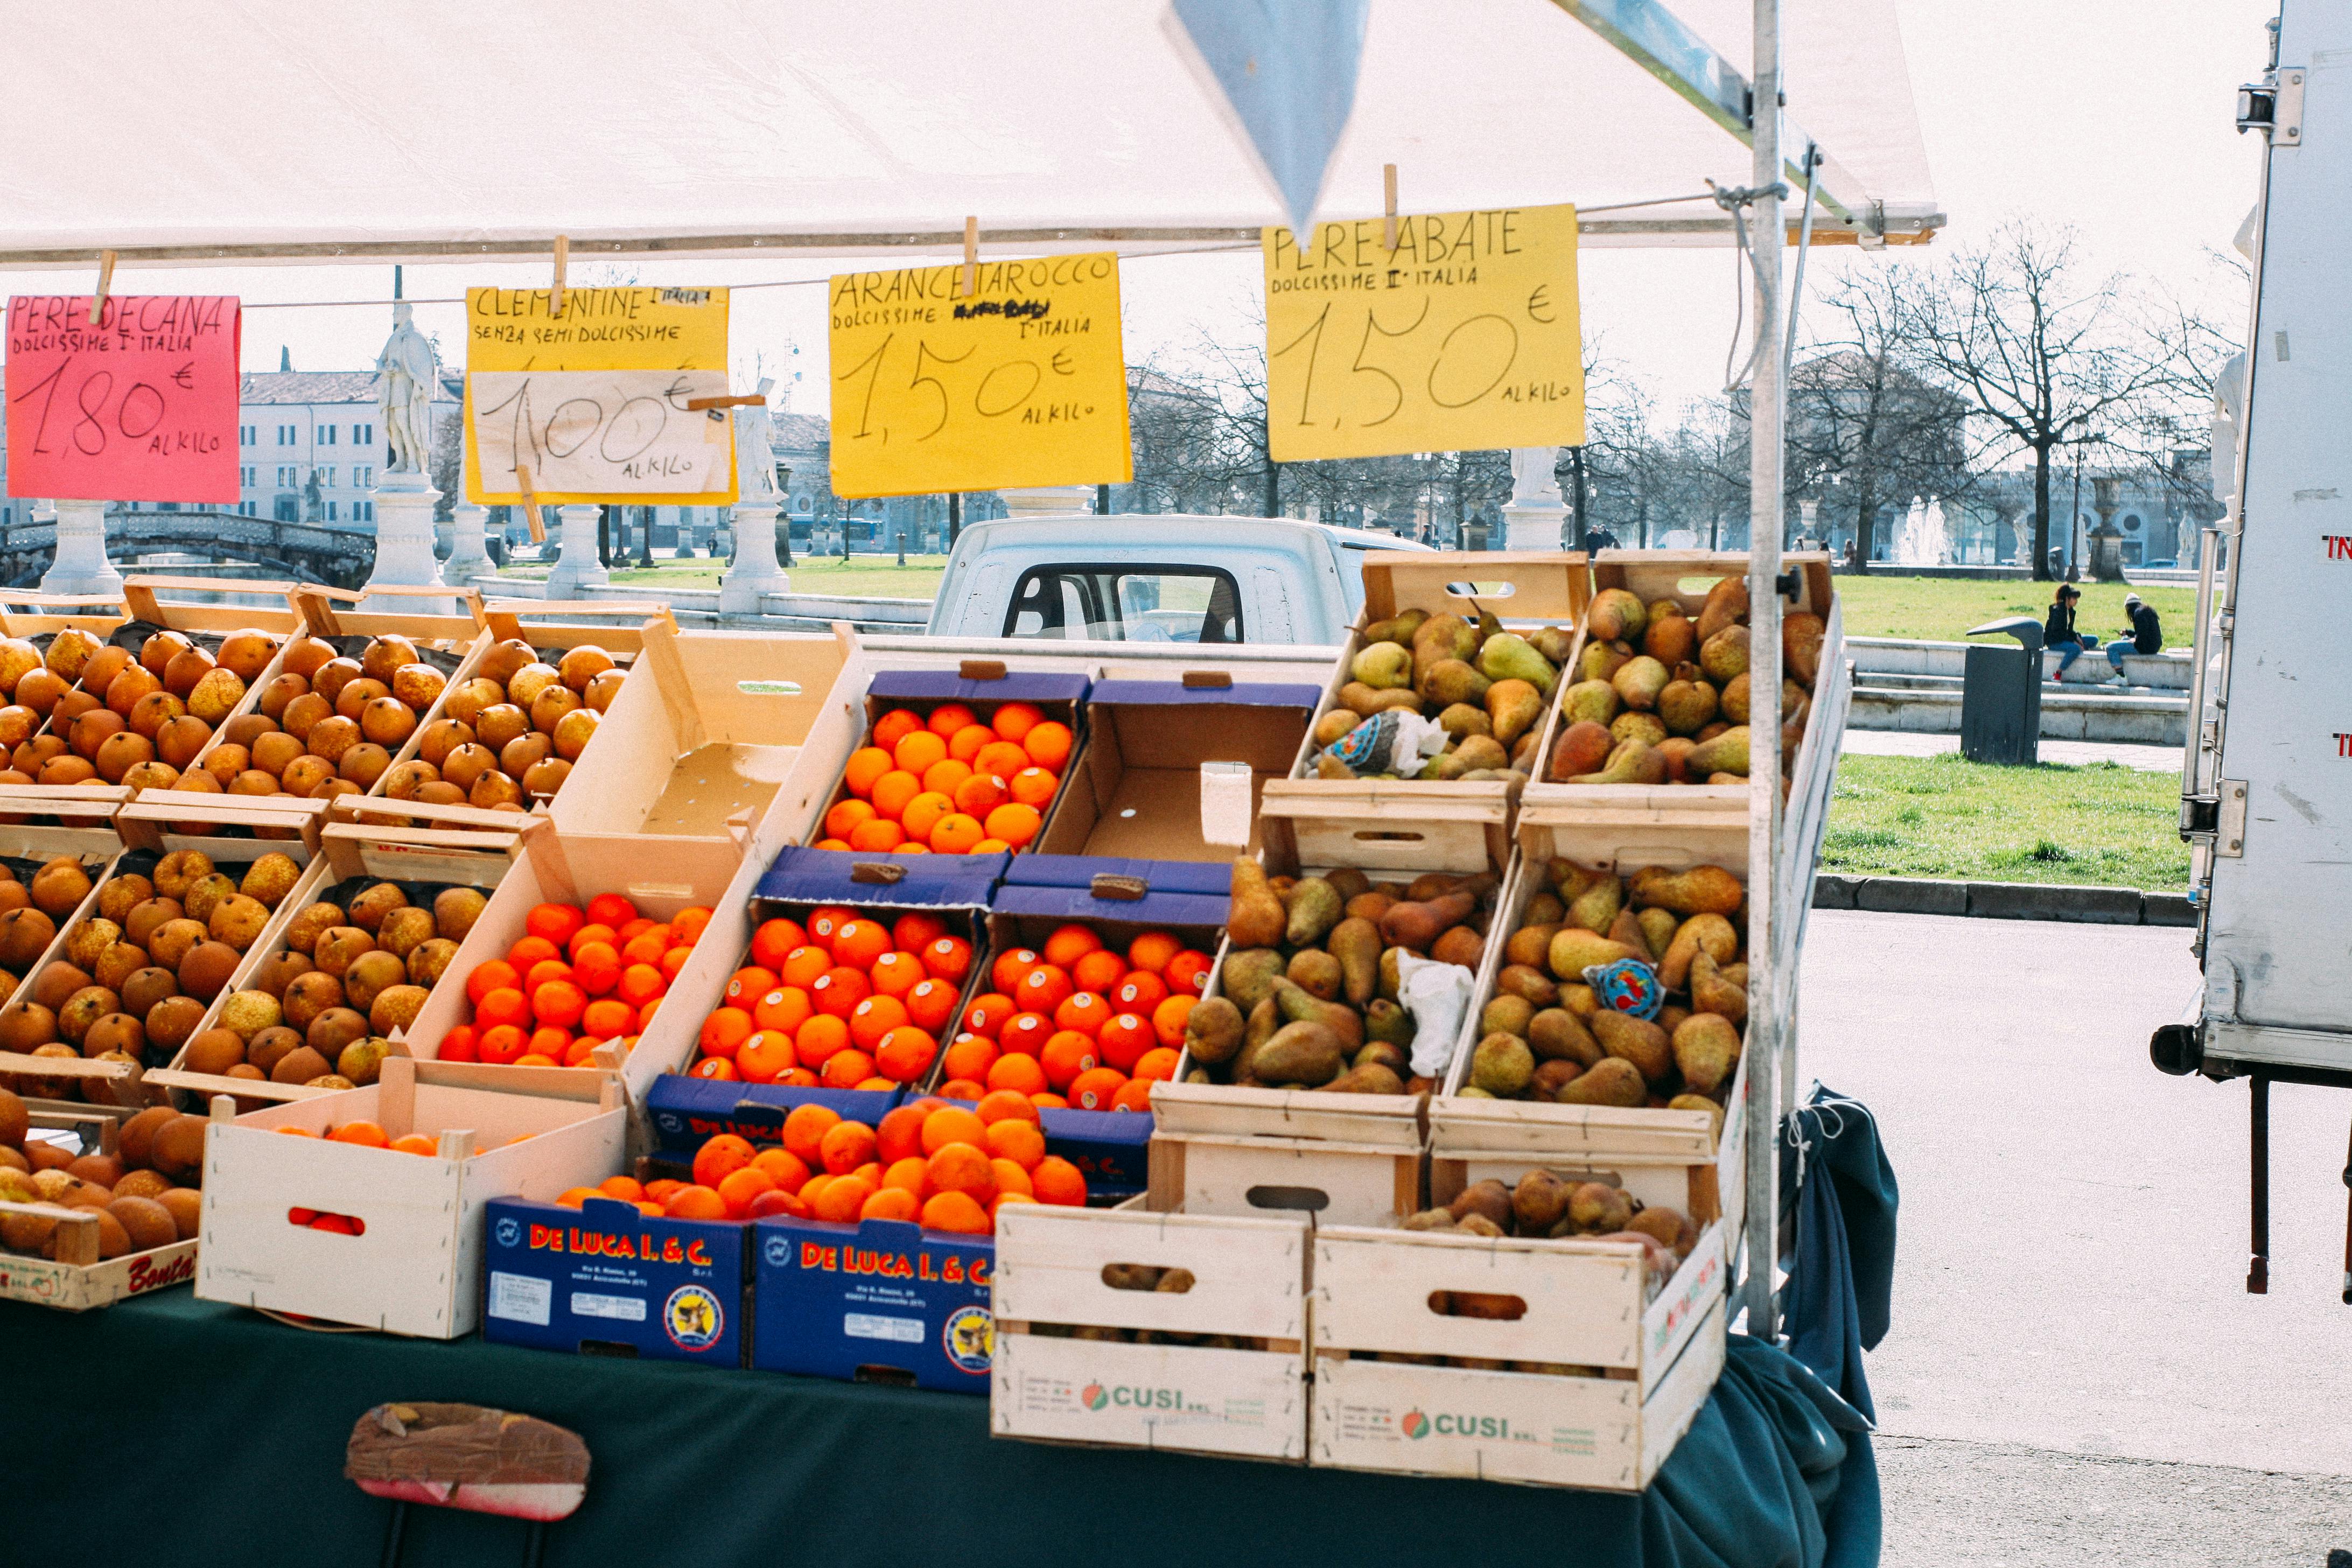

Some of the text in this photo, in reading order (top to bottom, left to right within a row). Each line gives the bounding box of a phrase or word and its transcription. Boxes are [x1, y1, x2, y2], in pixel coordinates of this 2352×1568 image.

[1389, 211, 1523, 267] ABATE
[833, 257, 1111, 308] ARANCE TAROCCO
[1416, 268, 1478, 286] ITALIA
[11, 296, 223, 336] PERE DECANA
[1529, 284, 1556, 324] €
[141, 335, 192, 352] ITALIA
[474, 326, 524, 345] SENZA
[1038, 317, 1090, 336] ITALIA
[1052, 346, 1076, 376] €
[13, 356, 195, 459] 1,80 €
[530, 1223, 564, 1252] DE
[569, 1227, 636, 1259] LUCA
[662, 1236, 684, 1264] &
[687, 1240, 712, 1266] C.
[801, 1242, 837, 1271] DE
[843, 1245, 914, 1279] LUCA
[943, 1255, 965, 1284] &
[1113, 1385, 1182, 1410] CUSI
[1435, 1413, 1507, 1439] CUSI
